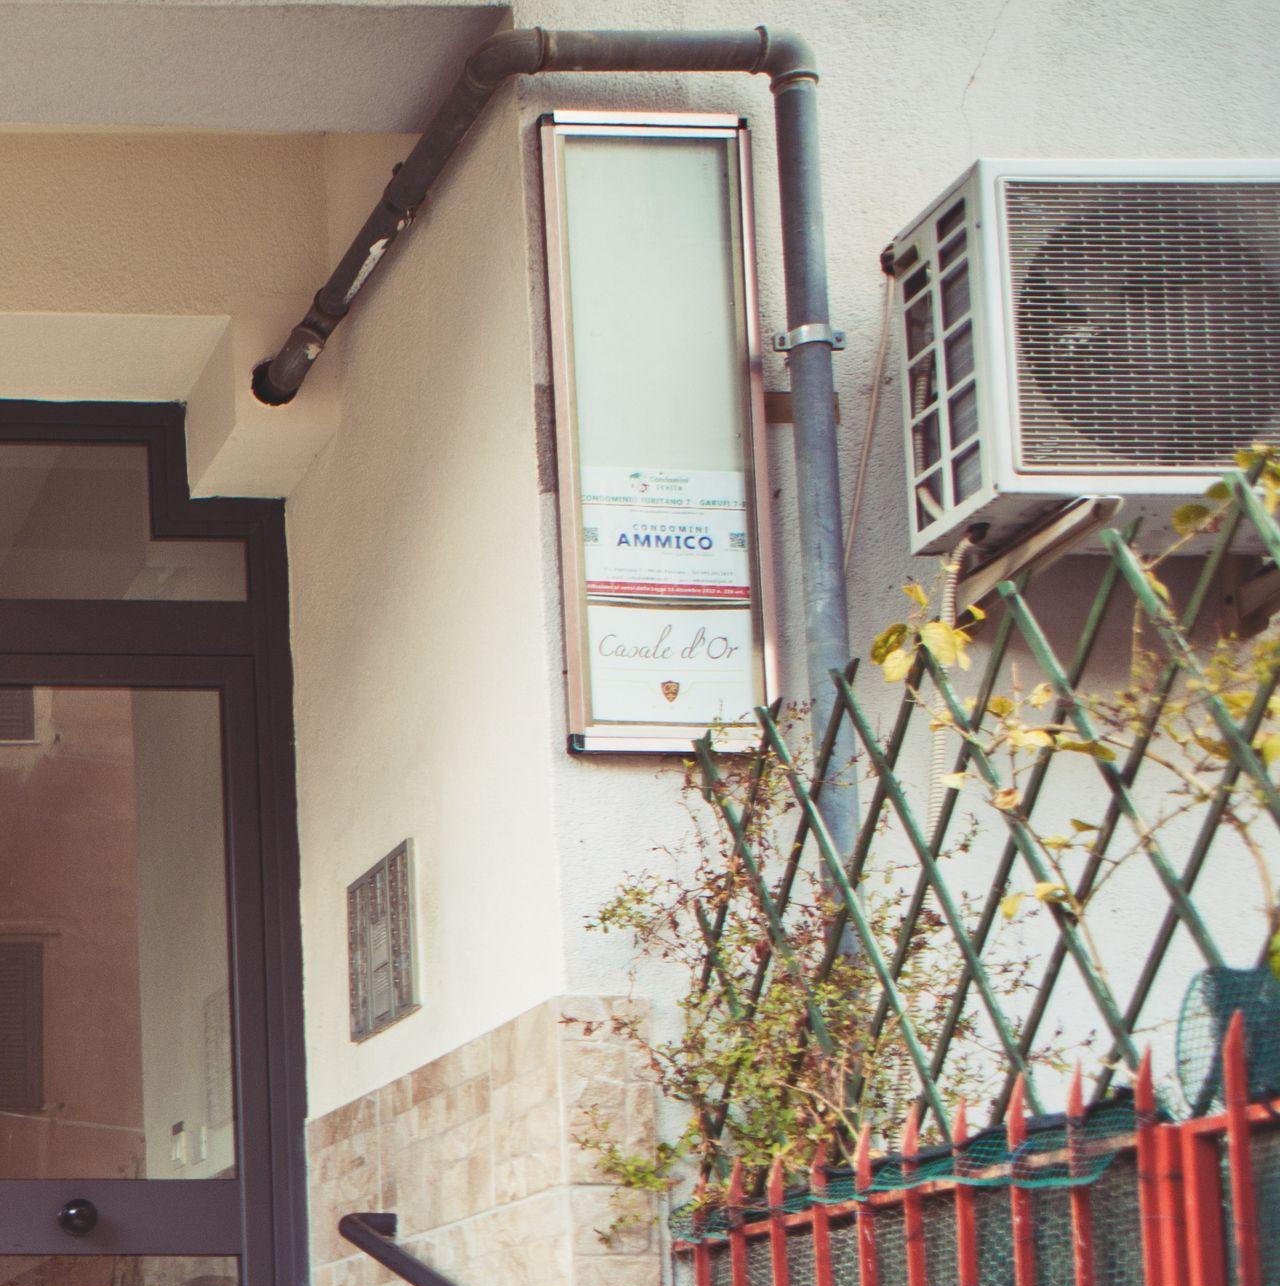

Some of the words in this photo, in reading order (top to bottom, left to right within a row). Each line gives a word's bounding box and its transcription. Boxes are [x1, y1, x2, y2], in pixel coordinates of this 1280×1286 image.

[632, 523, 709, 533] CONDOMINI
[616, 532, 713, 550] AMMICO
[599, 624, 673, 660] Casale
[680, 626, 739, 660] d'Or
